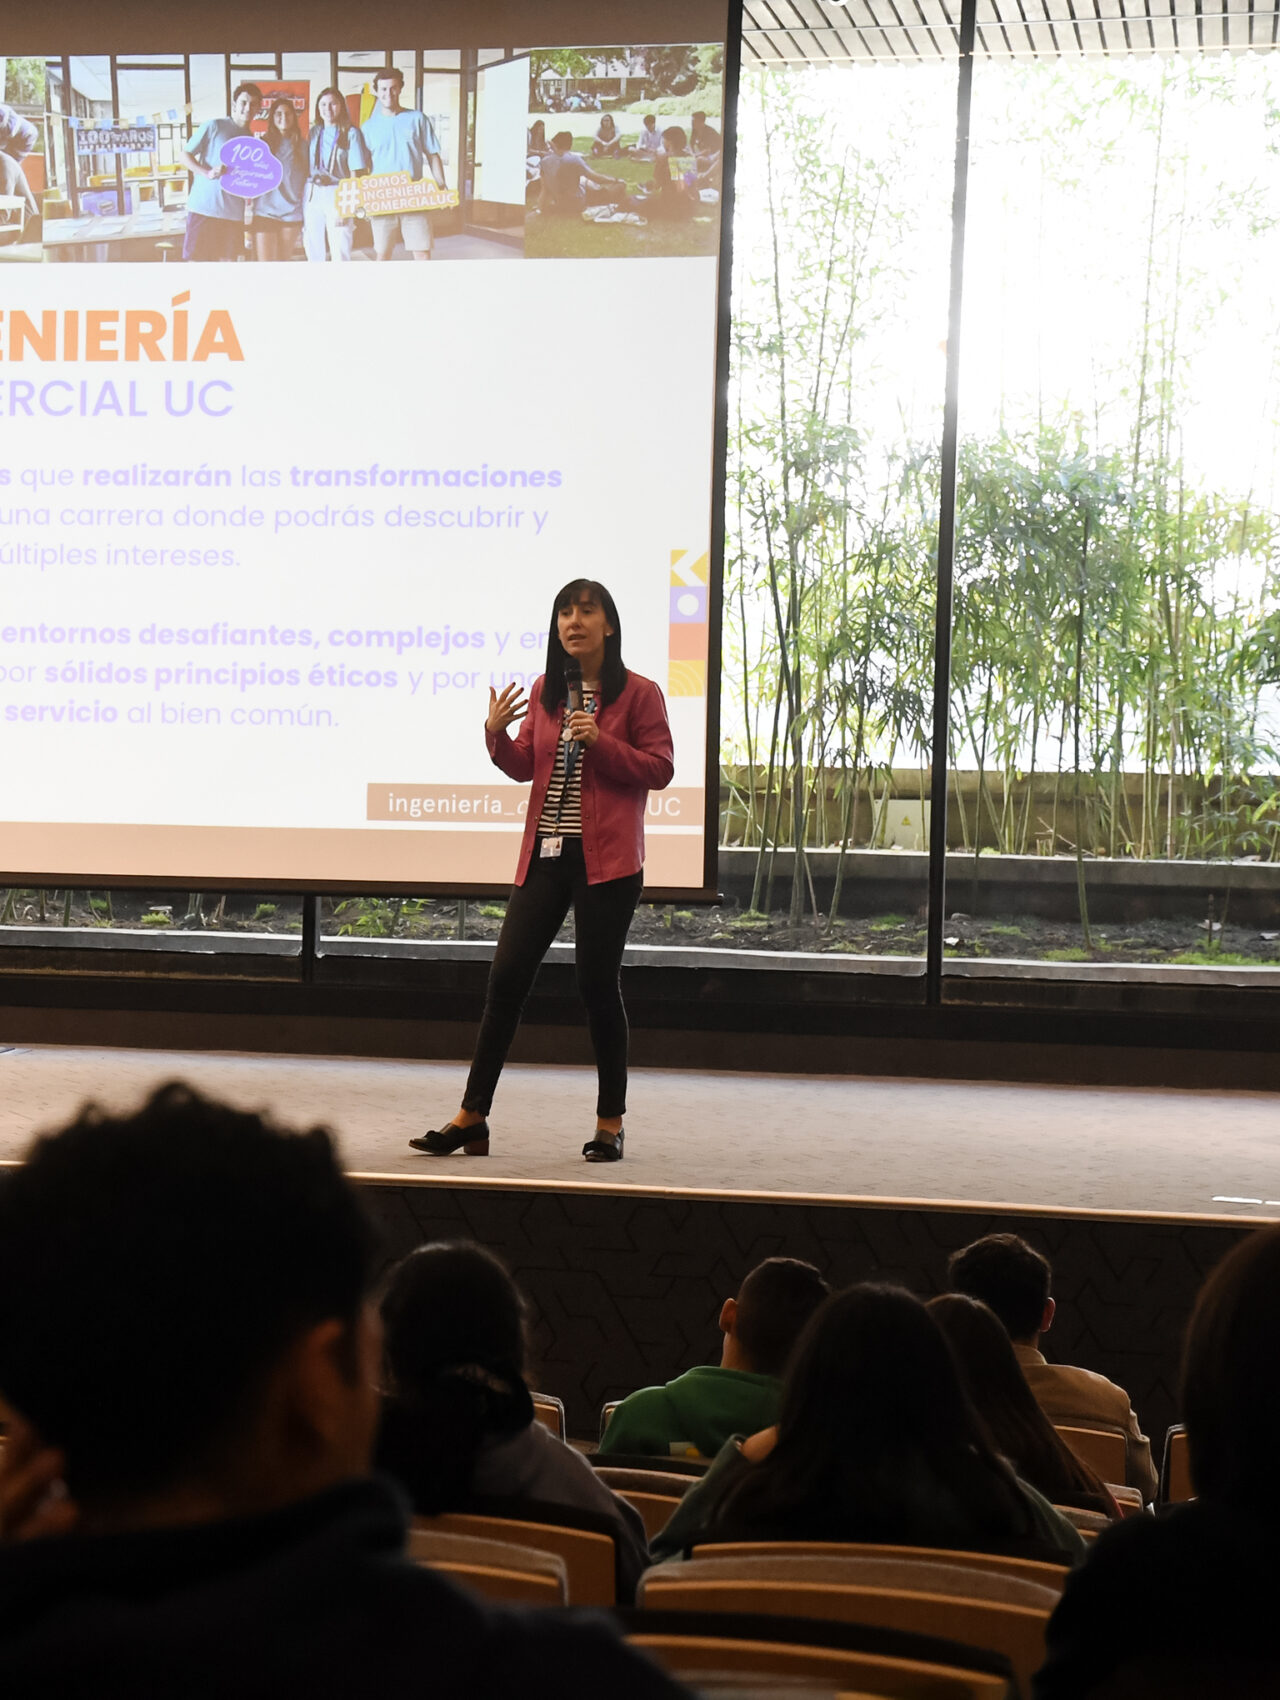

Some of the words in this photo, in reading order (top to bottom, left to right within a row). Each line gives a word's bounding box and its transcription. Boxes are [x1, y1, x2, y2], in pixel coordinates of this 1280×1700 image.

[231, 143, 264, 163] 100
[362, 174, 408, 190] SOMOS
[363, 181, 436, 201] INGENIERÍA
[164, 379, 234, 418] UC
[20, 468, 74, 494] que
[83, 462, 232, 488] realizarán
[241, 464, 282, 488] las
[289, 462, 562, 488] transformaciones
[60, 508, 164, 526] carrera
[172, 504, 264, 527] donde
[274, 504, 375, 535] podrás
[384, 504, 524, 528] descubrir
[532, 511, 548, 536] y
[107, 544, 240, 567] intereses.
[1, 623, 132, 645] entornos
[139, 621, 320, 650] desafiantes,
[328, 624, 486, 656] complejos
[494, 632, 512, 656] y
[45, 660, 148, 684] sólidos
[154, 661, 301, 693] principios
[308, 662, 399, 688] éticos
[408, 672, 423, 696] y
[432, 672, 480, 696] por
[5, 698, 119, 724] servicio
[128, 702, 152, 726] al
[161, 702, 222, 726] bien
[230, 704, 339, 728] común.
[388, 793, 529, 817] ingeniería_c
